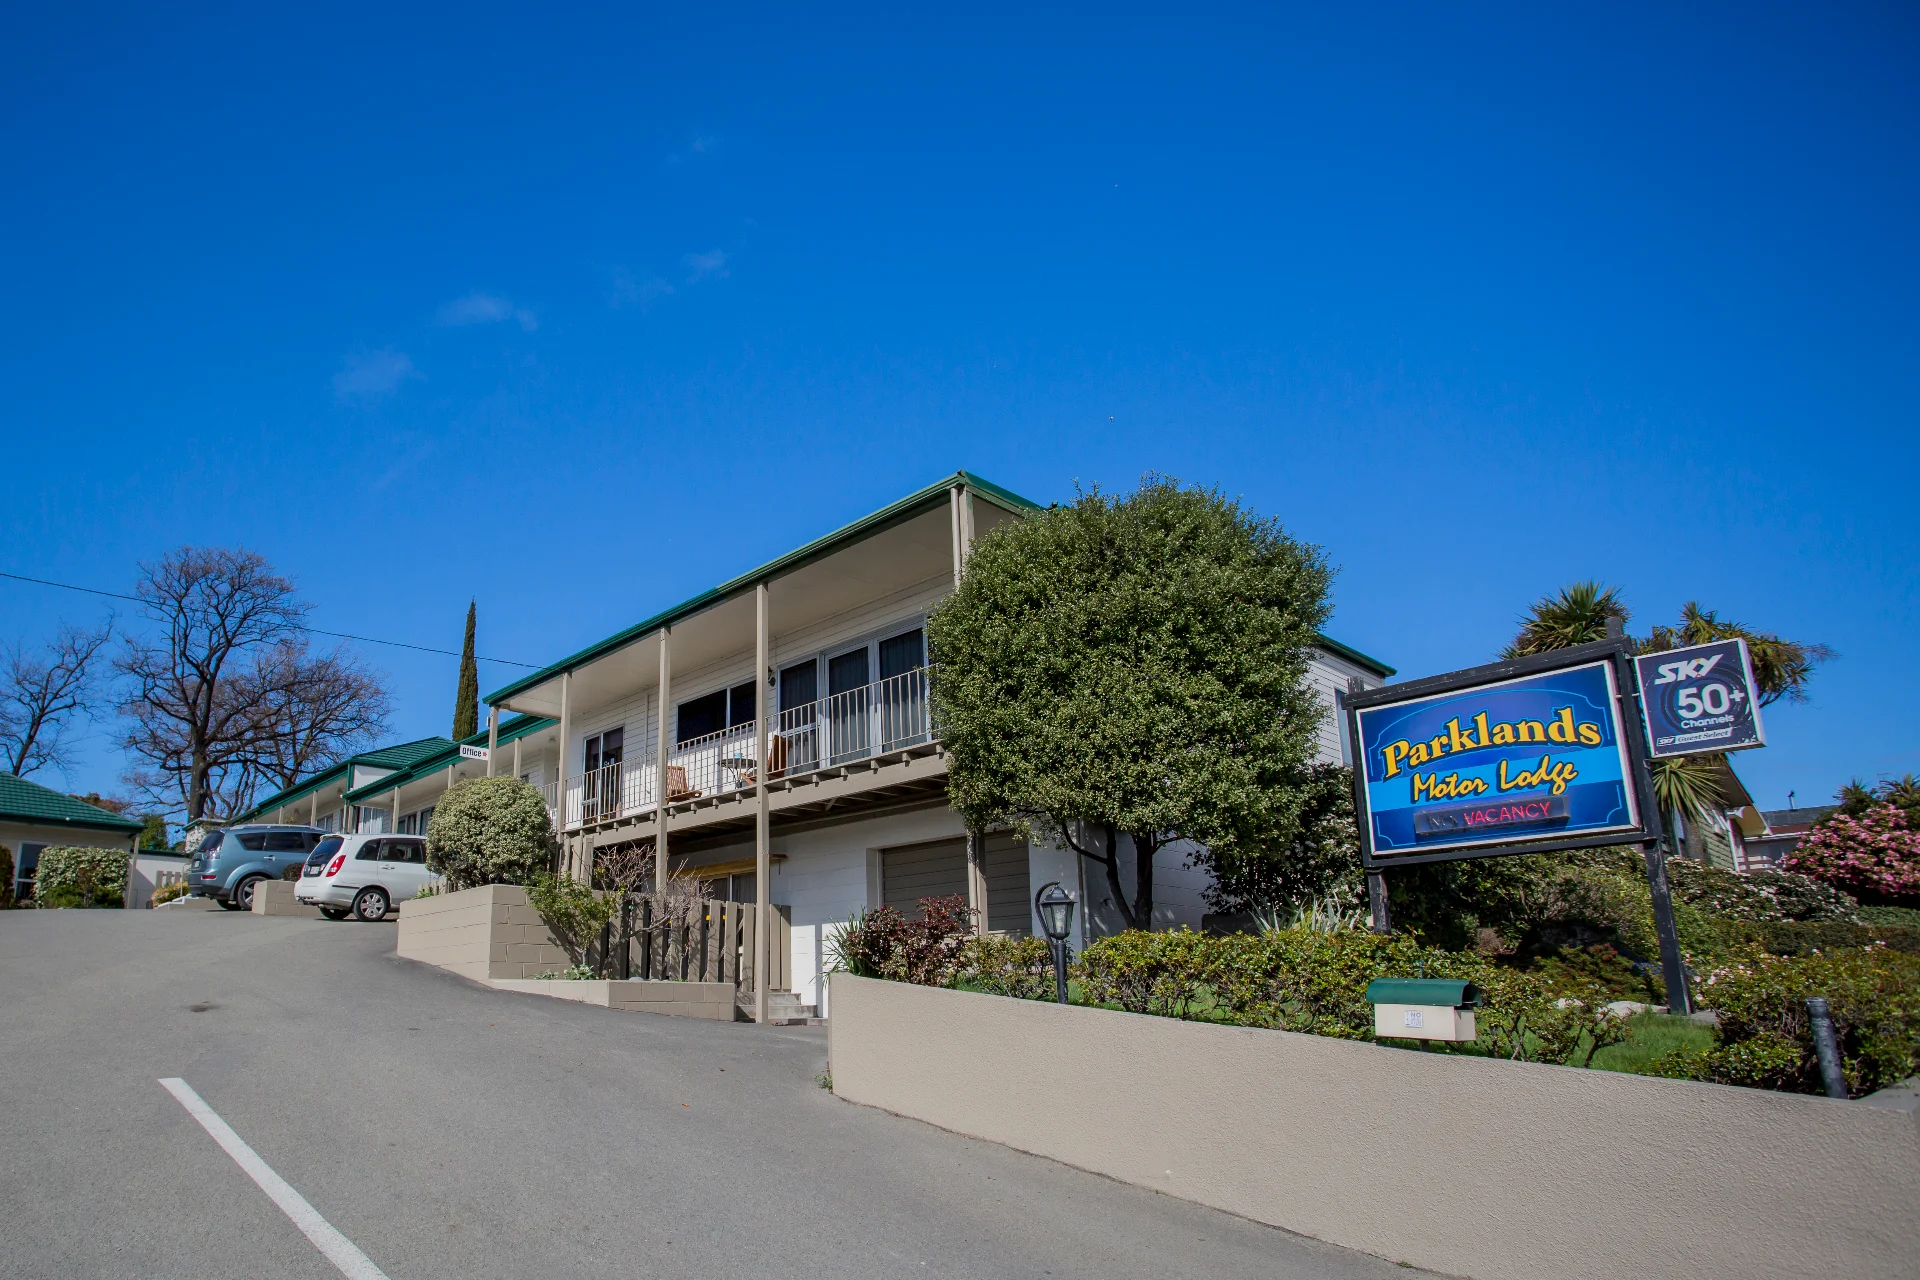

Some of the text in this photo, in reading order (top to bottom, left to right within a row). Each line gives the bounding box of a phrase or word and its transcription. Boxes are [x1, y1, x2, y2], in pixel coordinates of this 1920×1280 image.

[1654, 653, 1724, 685] SKY
[1678, 683, 1745, 719] 50+
[1681, 714, 1735, 729] Channels
[1382, 707, 1602, 778] Parklands
[1677, 733, 1702, 743] Guest
[1703, 730, 1729, 739] Select
[462, 747, 482, 757] Office
[1413, 755, 1578, 801] Motor Lodge
[1463, 801, 1551, 826] VACANCY
